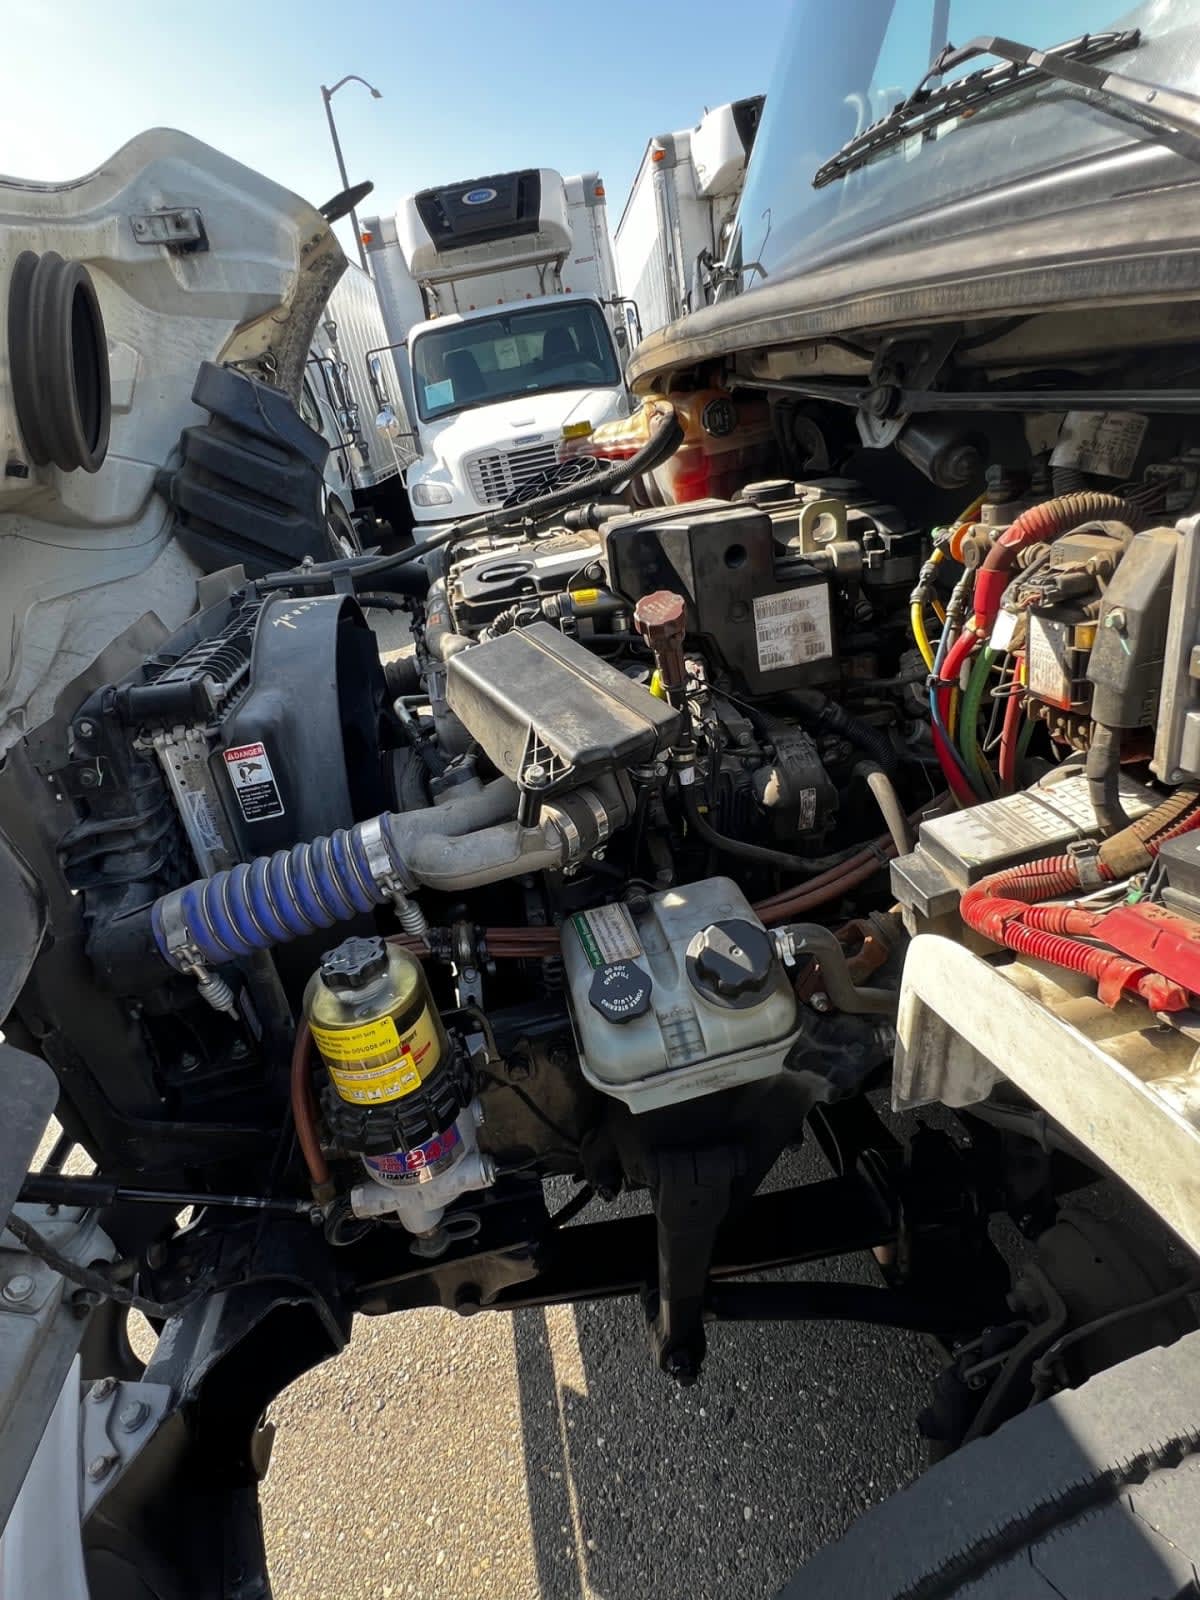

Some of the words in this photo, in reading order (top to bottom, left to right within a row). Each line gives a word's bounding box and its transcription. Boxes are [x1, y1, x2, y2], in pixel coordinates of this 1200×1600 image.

[233, 748, 263, 759] DANGER
[604, 967, 613, 976] DO
[603, 971, 629, 985] OVERFILL
[613, 994, 633, 1005] FLUID
[629, 989, 644, 1008] POWER
[601, 999, 629, 1012] STEERING
[386, 1171, 421, 1180] DAVCO
